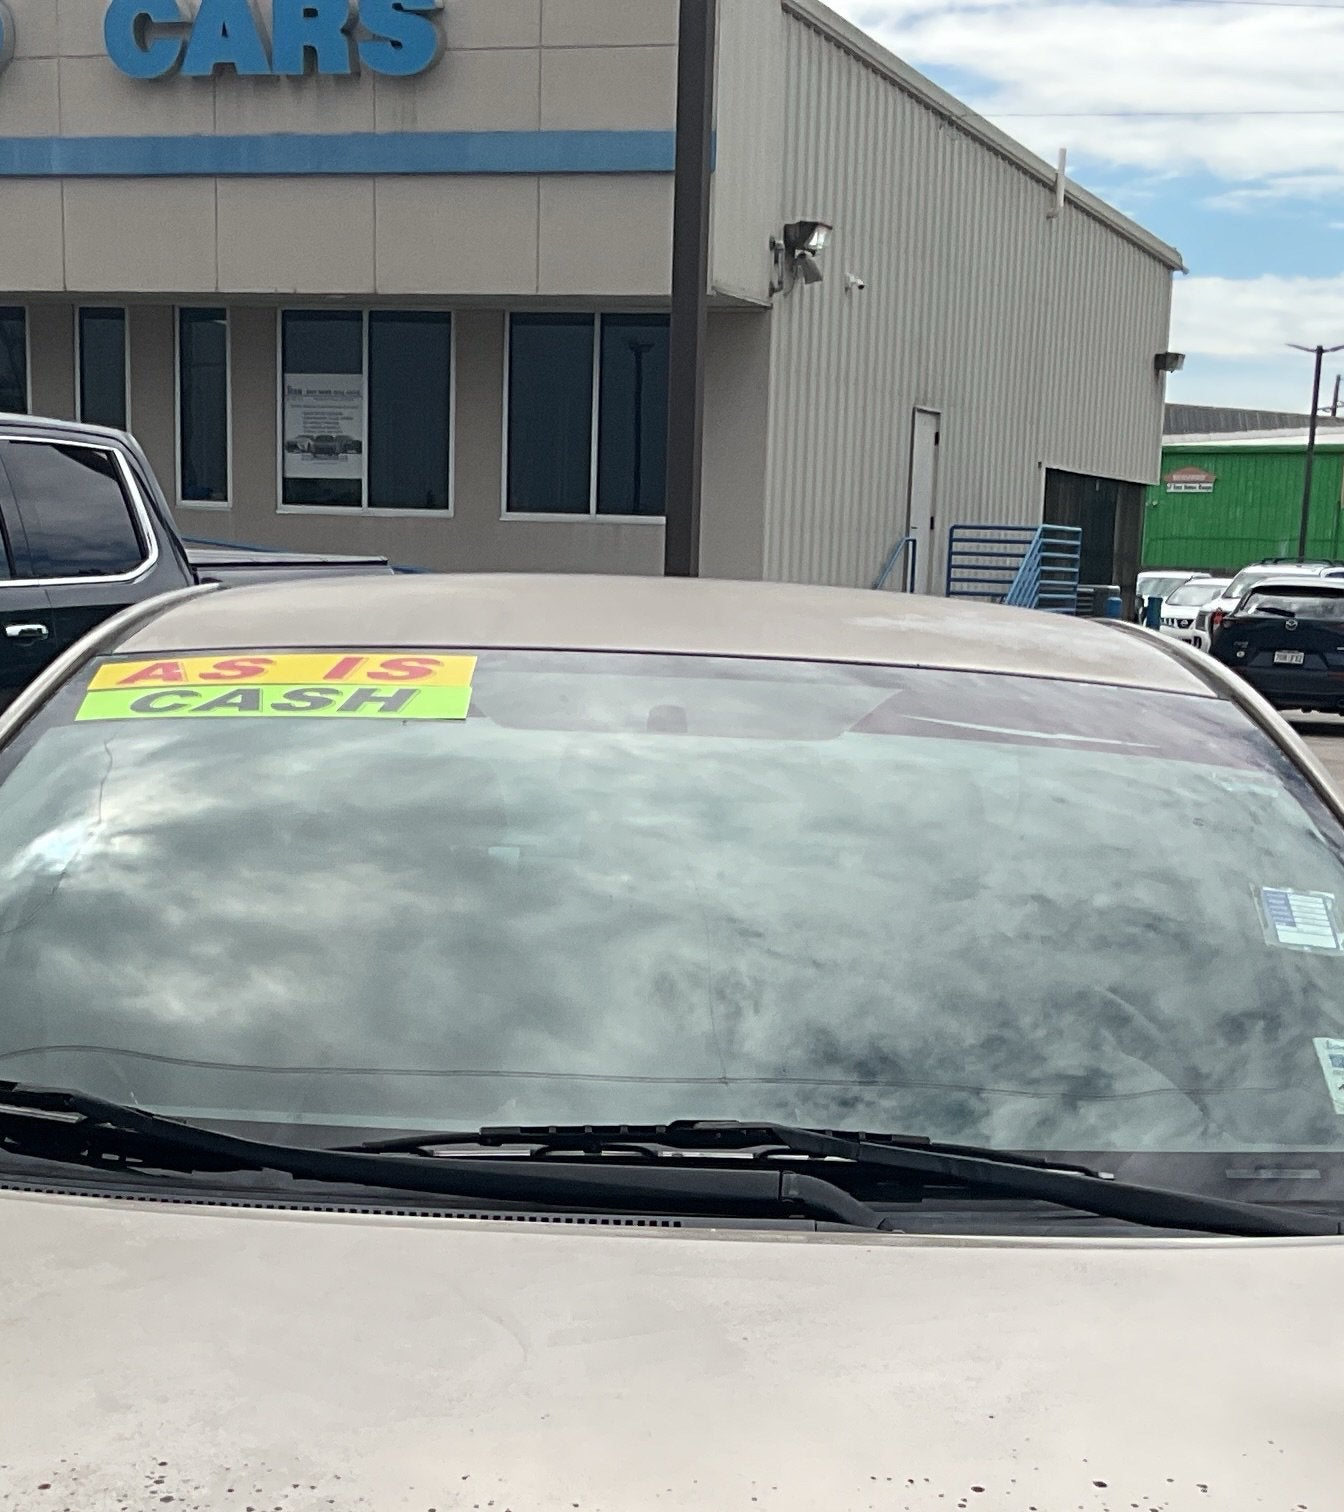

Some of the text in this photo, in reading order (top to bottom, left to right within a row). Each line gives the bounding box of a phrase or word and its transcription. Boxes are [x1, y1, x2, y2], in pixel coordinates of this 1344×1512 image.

[104, 0, 446, 79] CARS
[116, 656, 445, 685] AS IS
[129, 687, 421, 714] CASH
